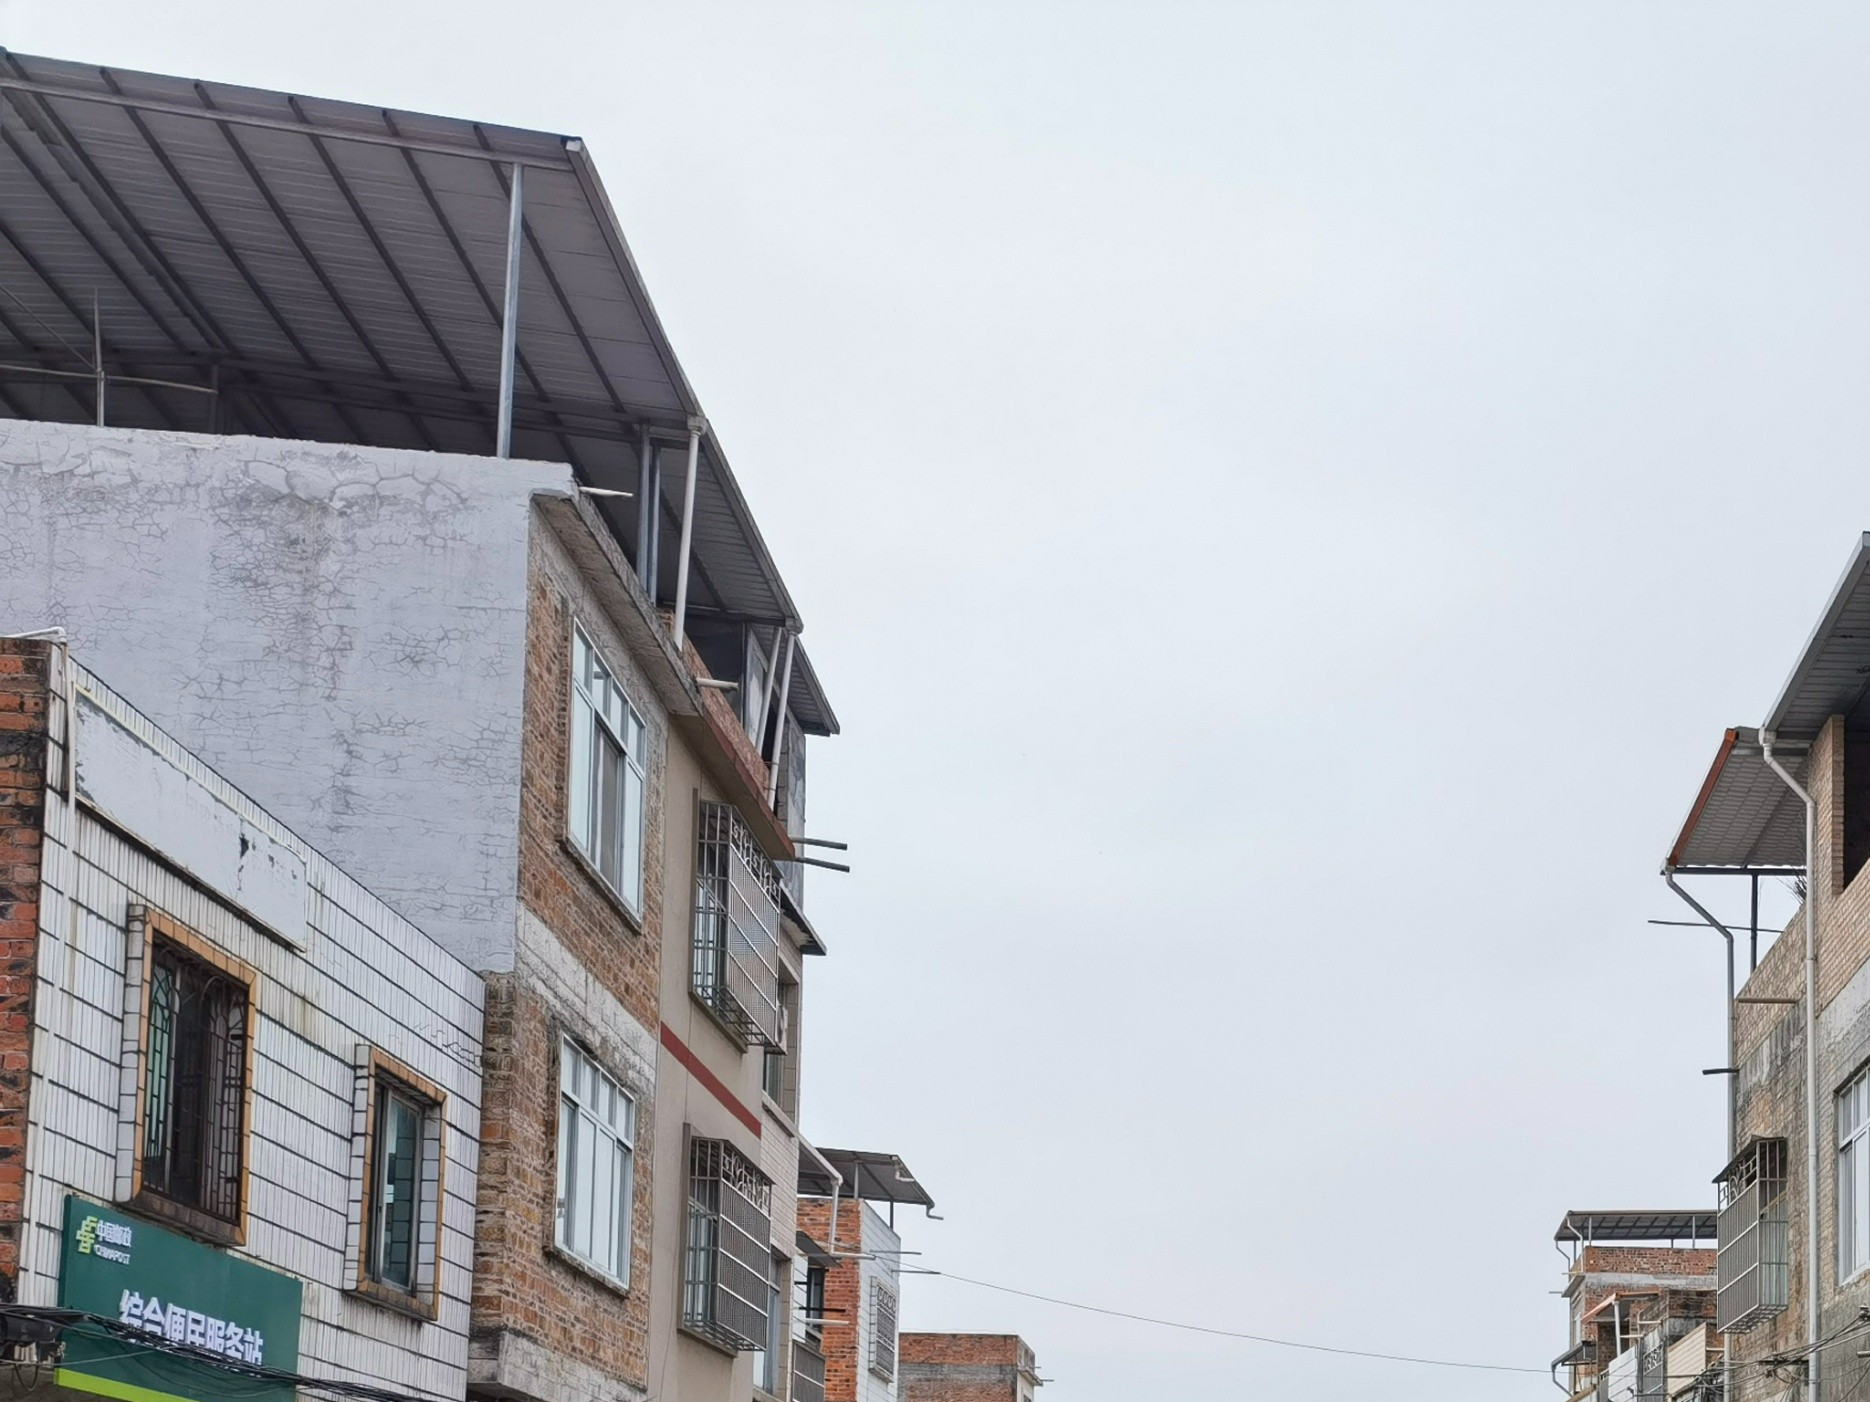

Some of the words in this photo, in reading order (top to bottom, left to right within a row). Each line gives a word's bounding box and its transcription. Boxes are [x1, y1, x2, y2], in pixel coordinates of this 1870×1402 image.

[119, 1289, 264, 1366] 综合便民服务站
